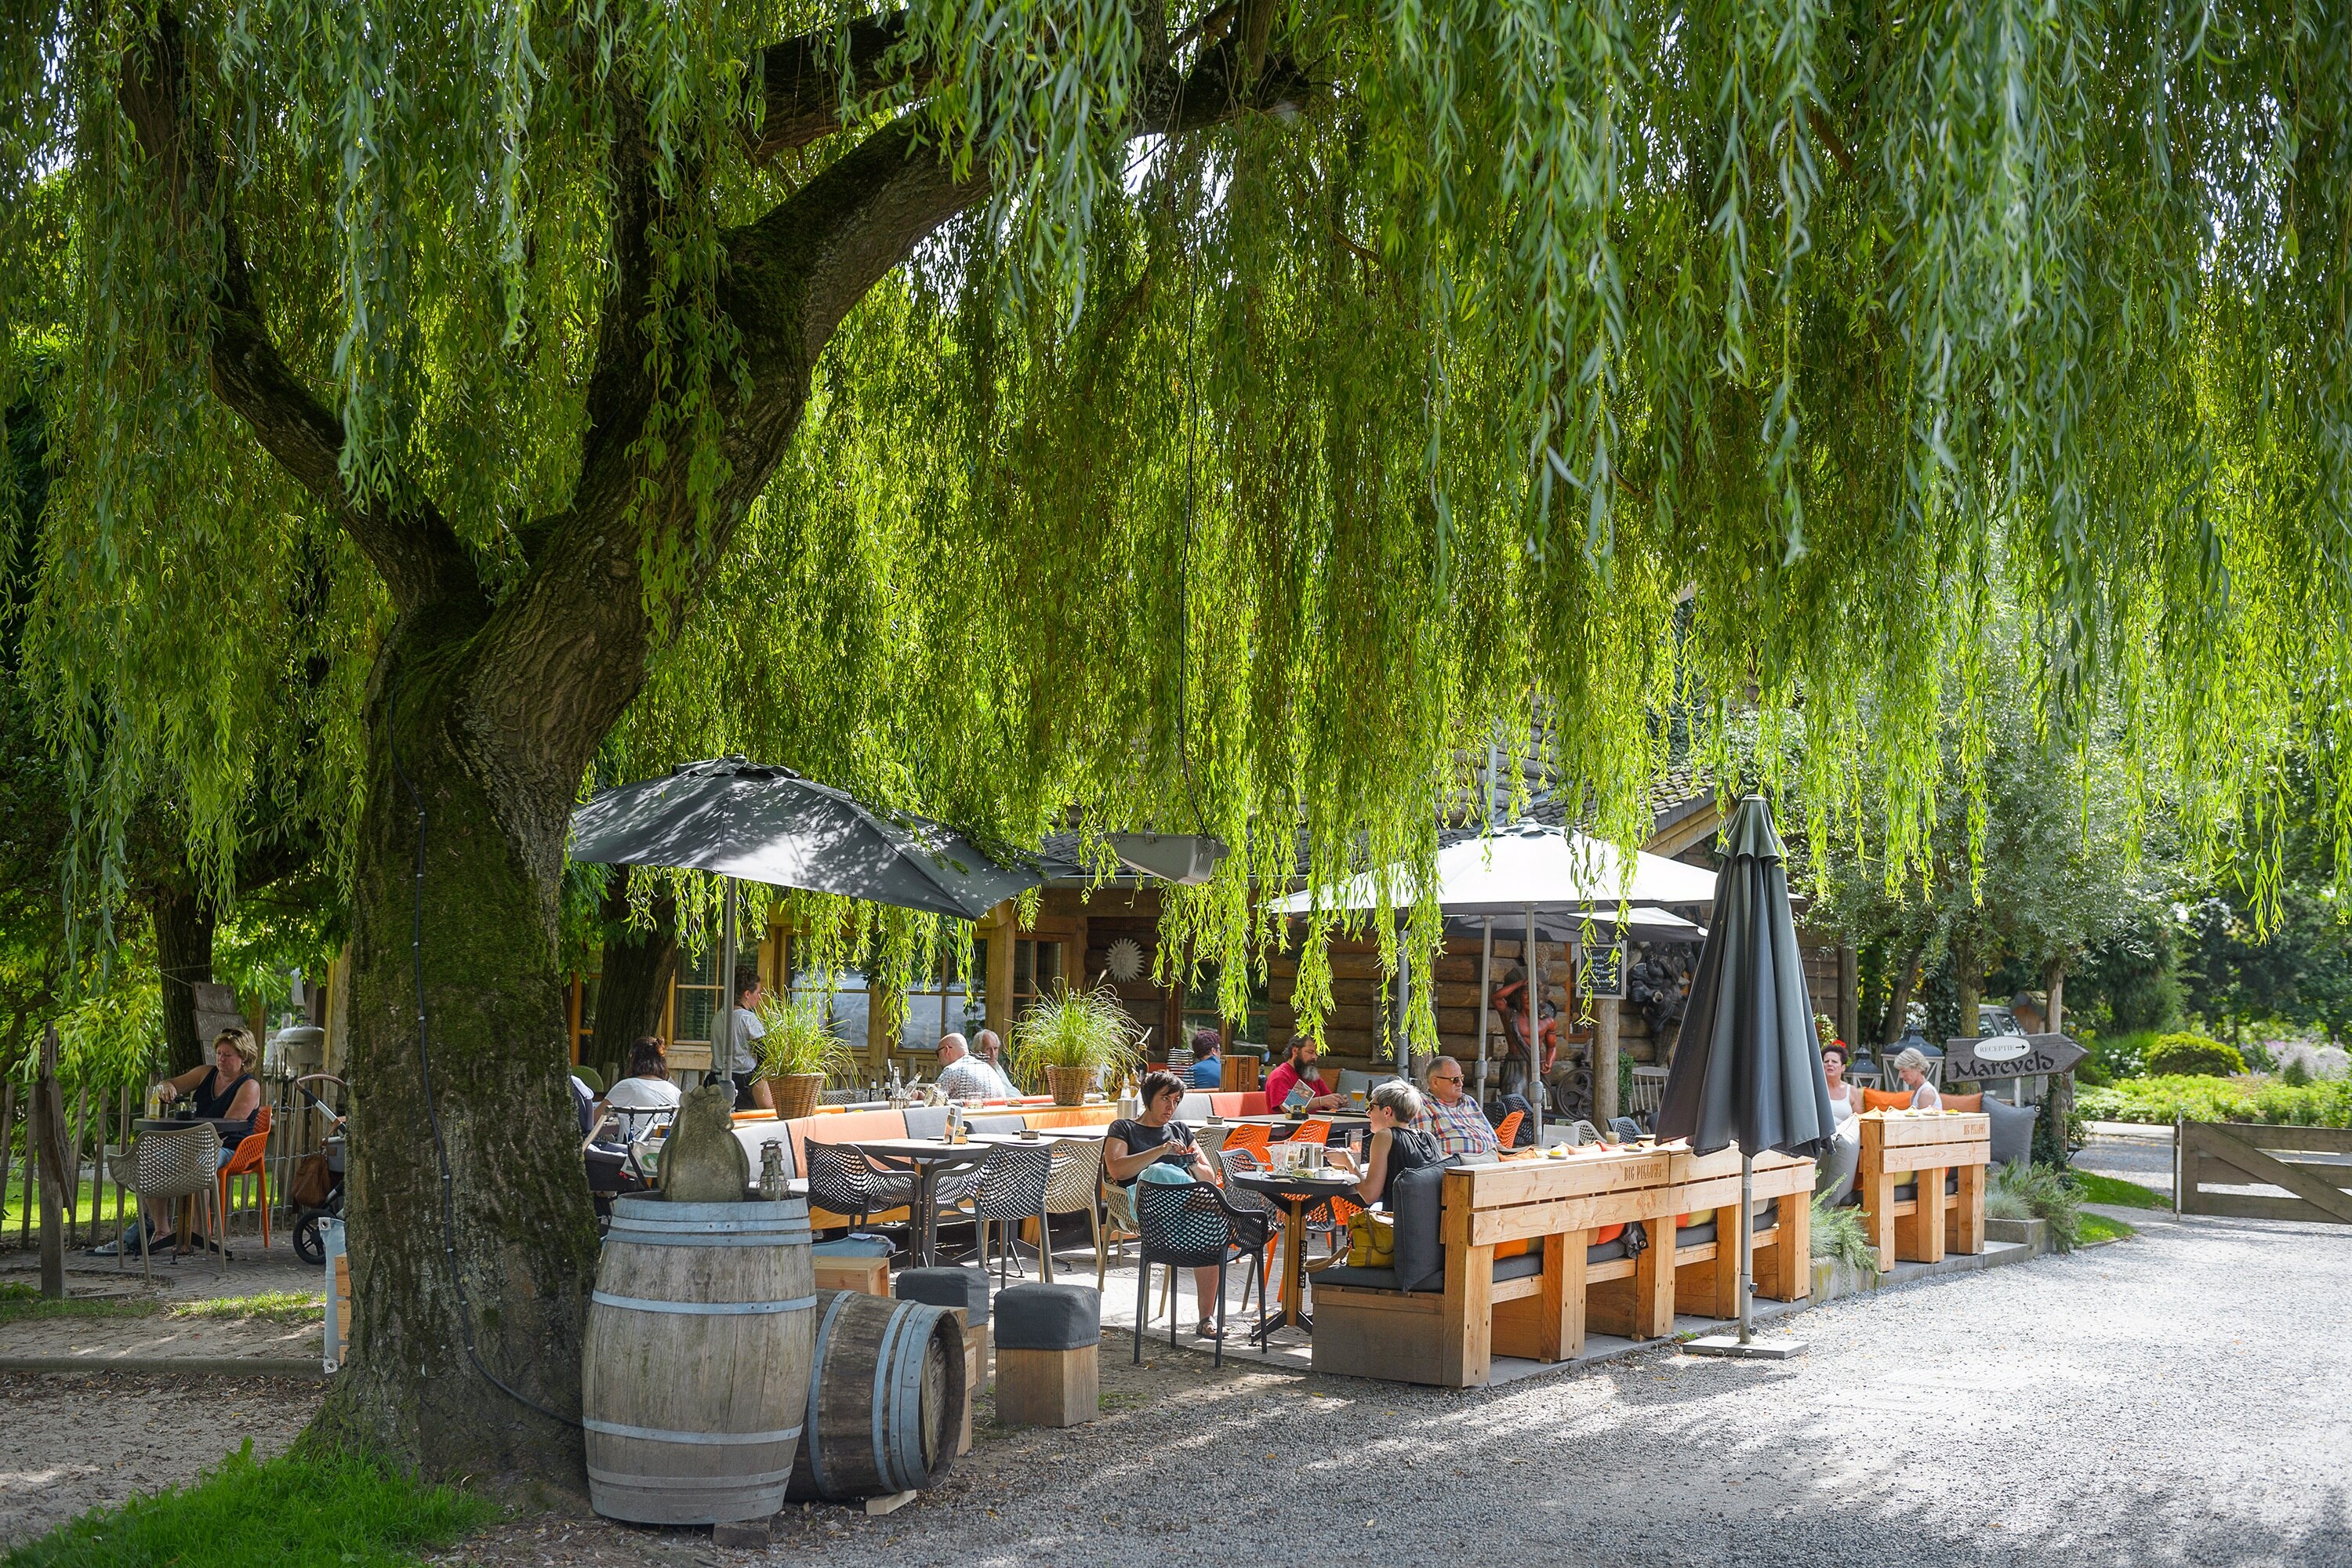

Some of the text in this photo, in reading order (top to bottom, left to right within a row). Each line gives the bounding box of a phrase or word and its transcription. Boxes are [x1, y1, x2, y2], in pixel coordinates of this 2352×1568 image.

[1980, 1044, 2014, 1053] RECEPTIE
[1955, 1051, 2054, 1079] Mareveld
[1624, 1163, 1662, 1181] BIG PILLOWS
